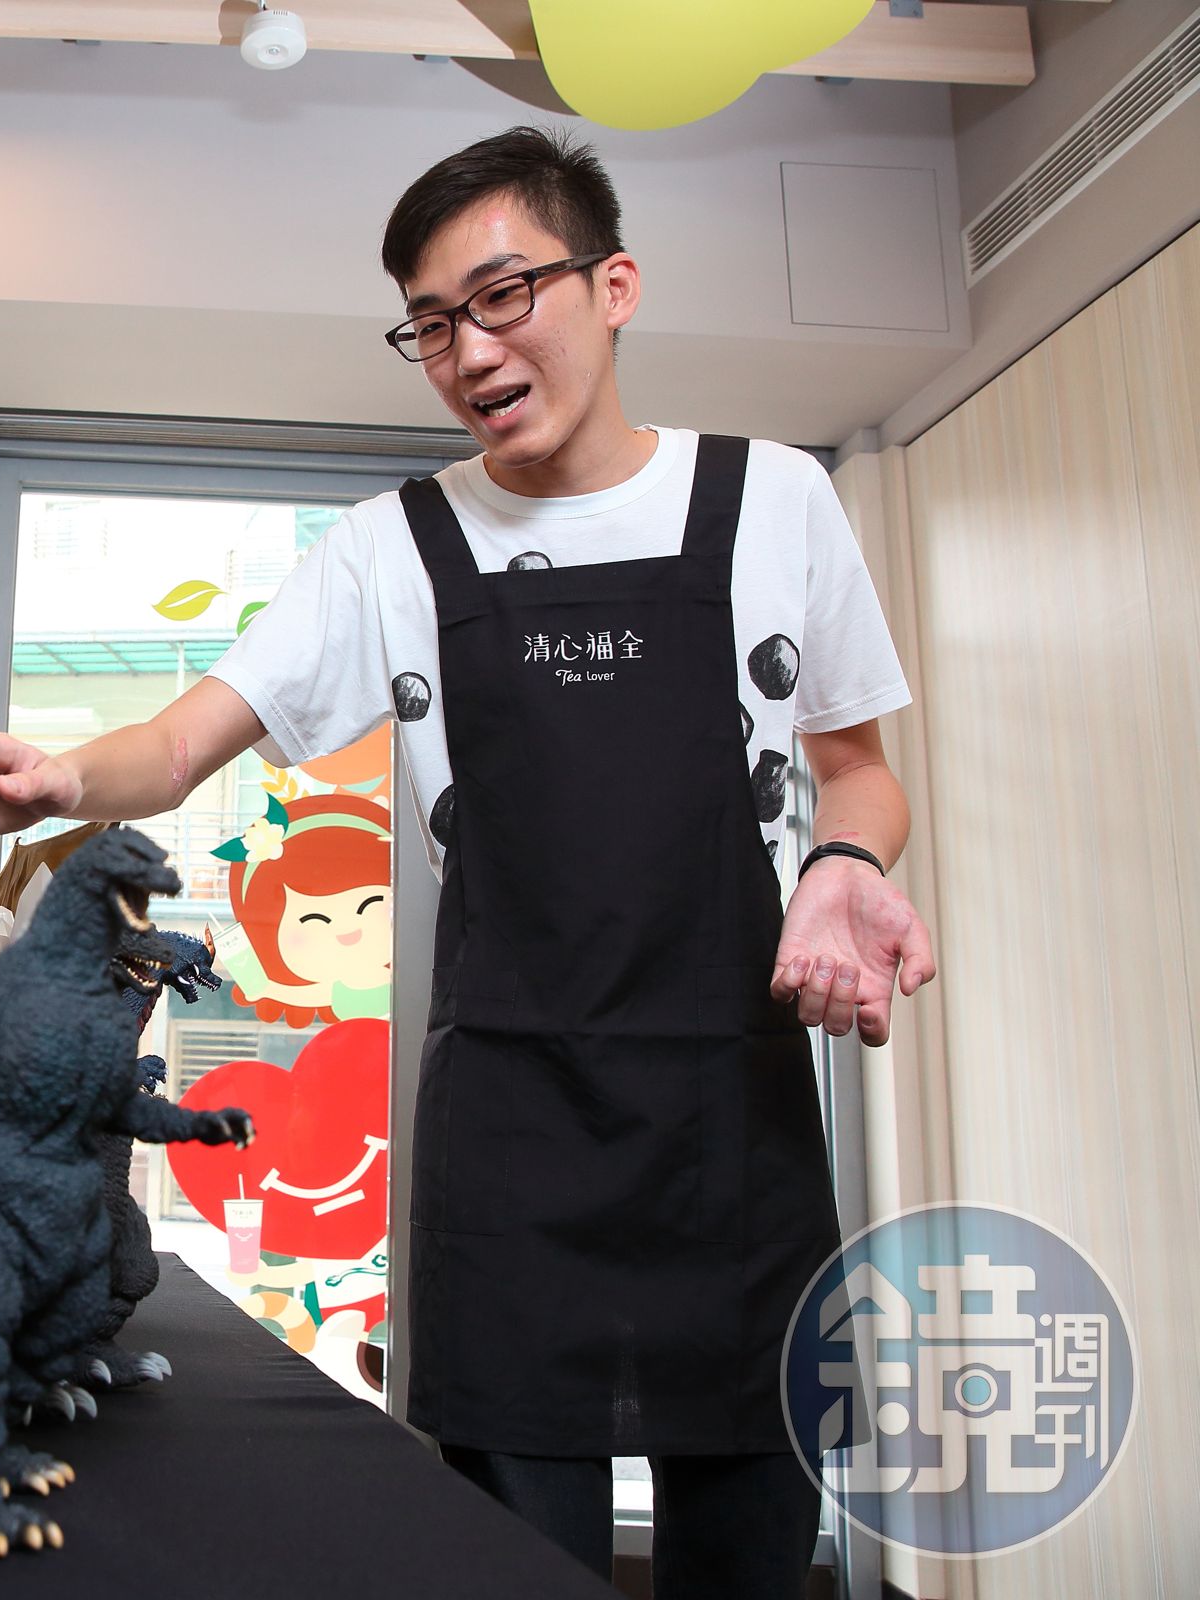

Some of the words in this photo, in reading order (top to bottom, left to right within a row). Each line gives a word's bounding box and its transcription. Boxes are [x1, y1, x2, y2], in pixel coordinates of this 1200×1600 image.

[523, 629, 644, 663] 清心福全
[555, 668, 582, 687] Tea
